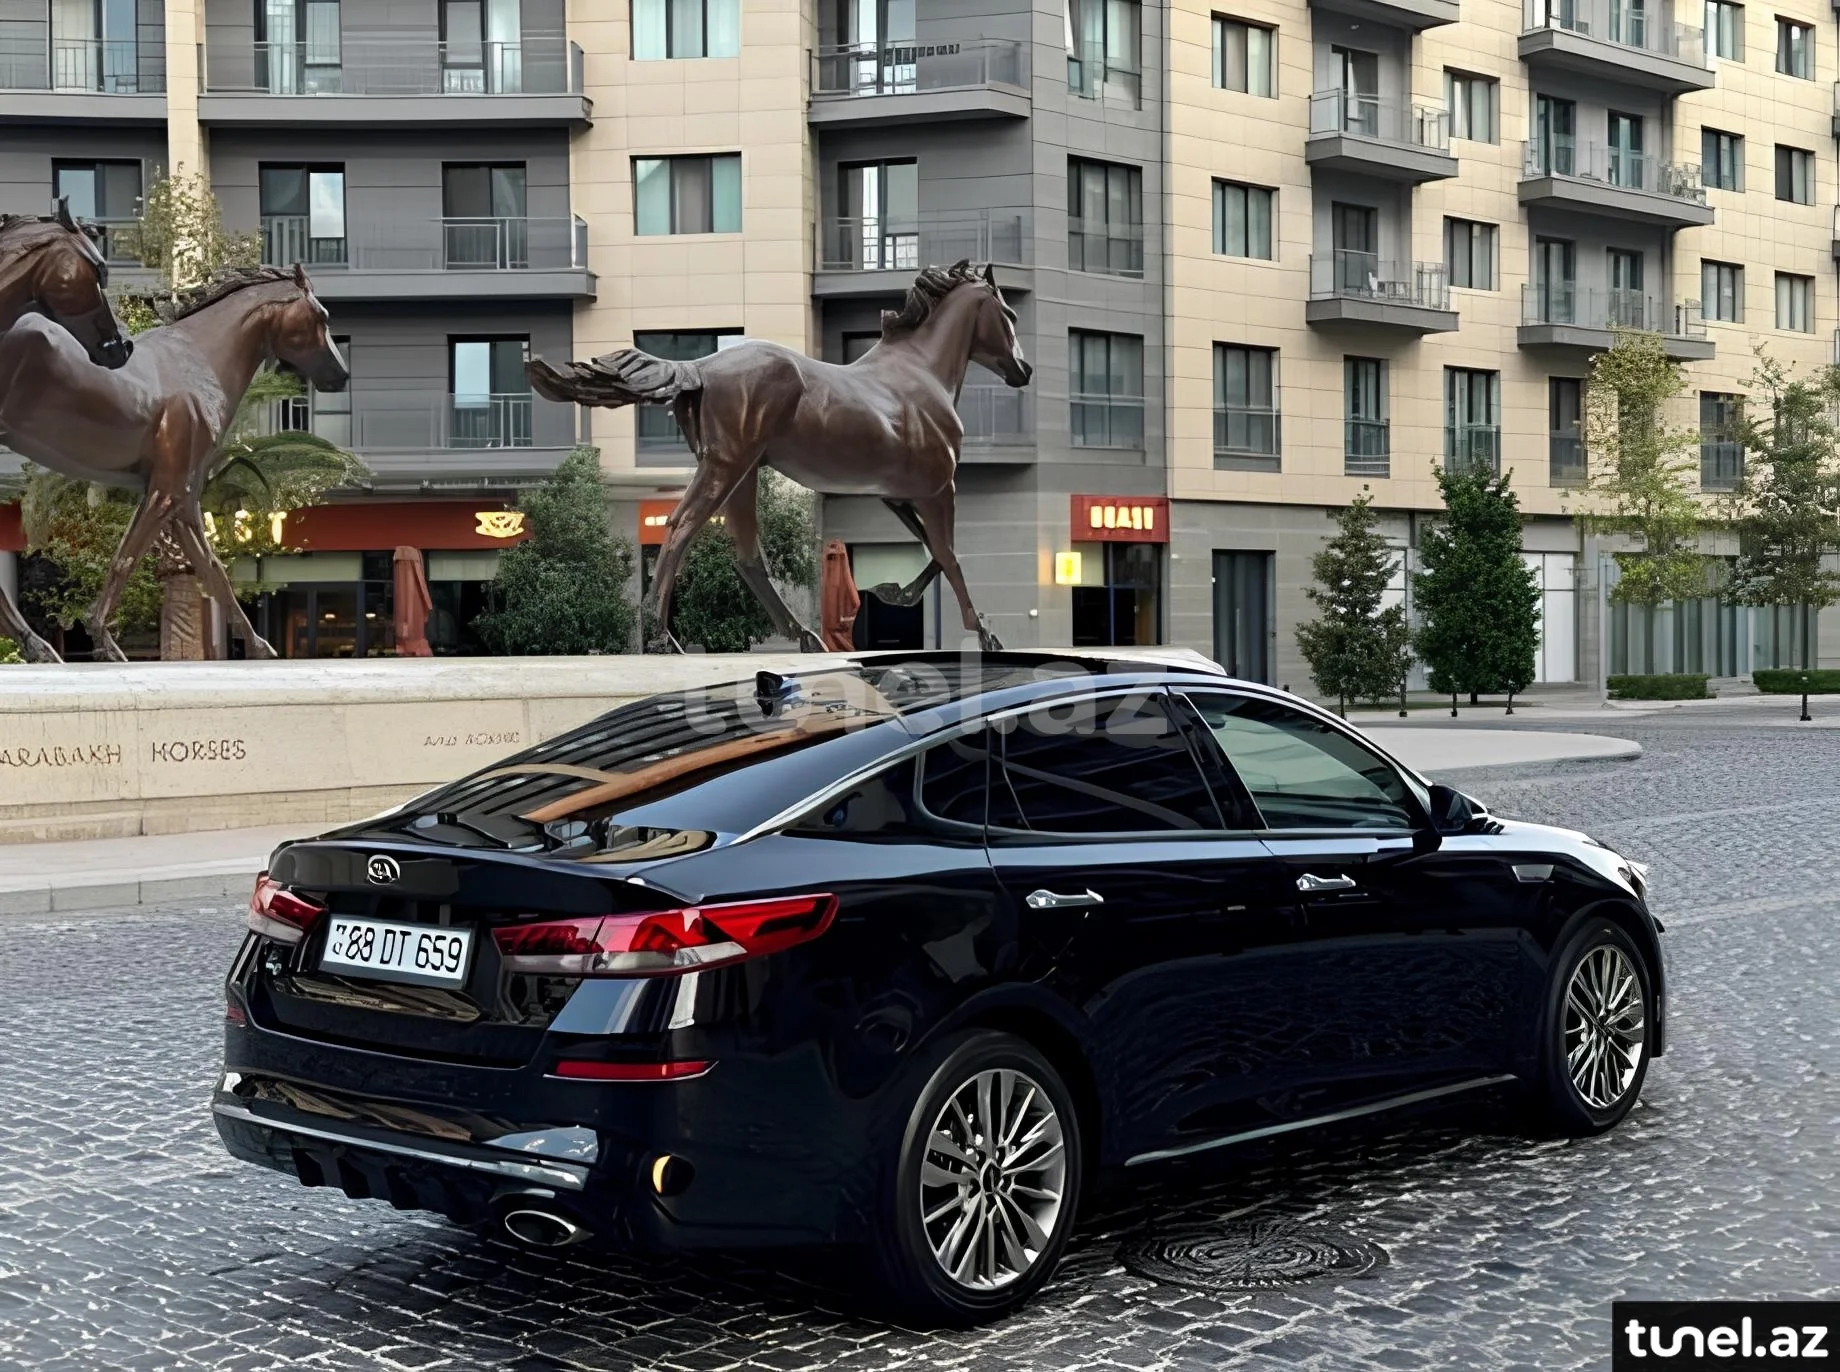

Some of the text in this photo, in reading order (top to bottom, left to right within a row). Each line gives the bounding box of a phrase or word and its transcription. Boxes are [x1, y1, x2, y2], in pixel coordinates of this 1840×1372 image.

[152, 739, 247, 763] HORSES
[379, 929, 412, 967] DT
[415, 933, 463, 973] 659
